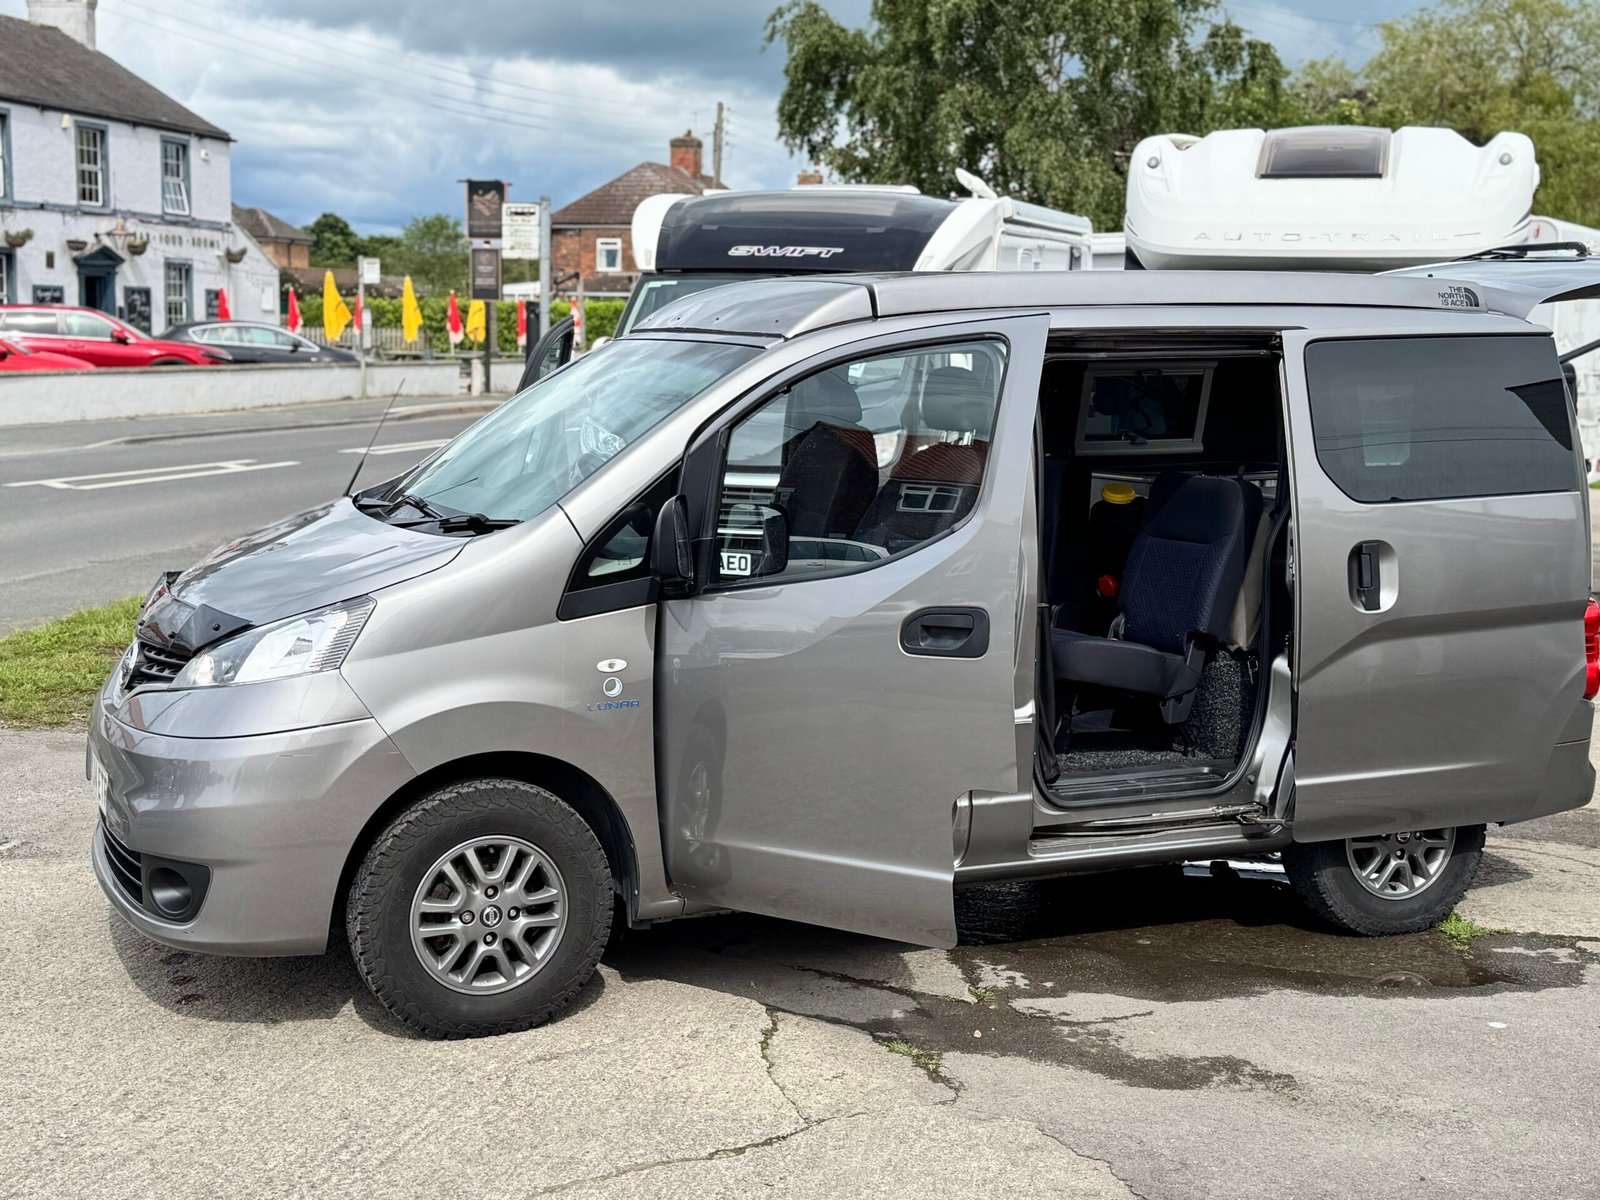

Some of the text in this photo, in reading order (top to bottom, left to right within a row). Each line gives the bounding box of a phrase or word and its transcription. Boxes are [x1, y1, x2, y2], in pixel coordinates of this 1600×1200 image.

[728, 245, 844, 258] SWIFT
[1438, 292, 1465, 300] NORTH
[1450, 299, 1465, 307] ACE
[586, 700, 640, 711] LUNAR
